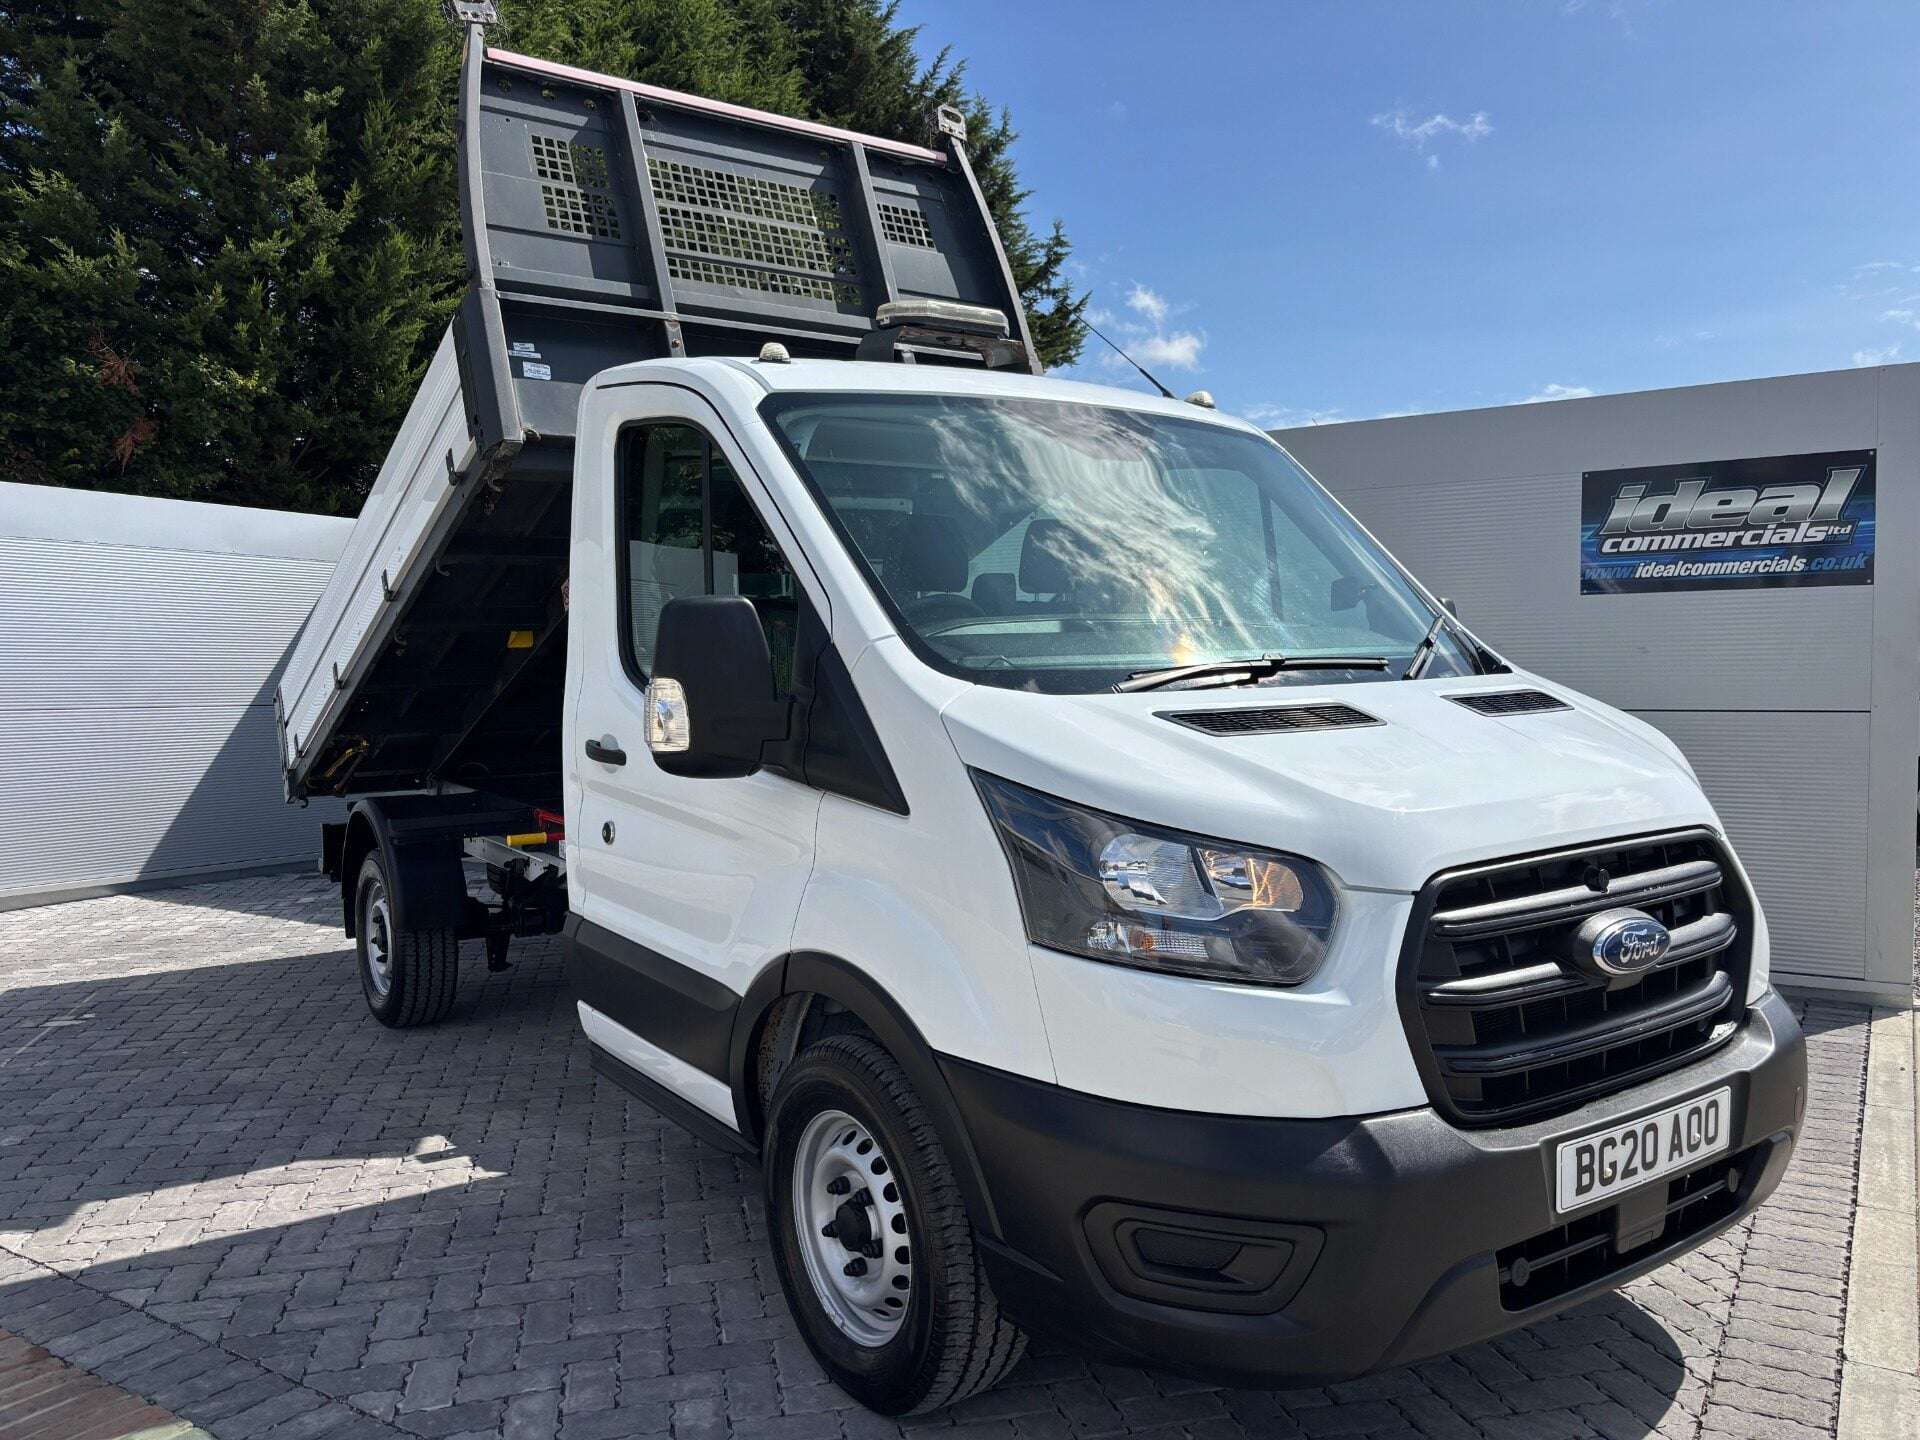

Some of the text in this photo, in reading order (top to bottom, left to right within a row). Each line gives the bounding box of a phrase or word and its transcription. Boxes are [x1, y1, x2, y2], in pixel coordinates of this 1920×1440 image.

[1599, 467, 1864, 535] ideal
[1602, 522, 1853, 553] commercials ltd
[1620, 928, 1667, 964] Ford
[1575, 1099, 1719, 1197] BG20 AOO
